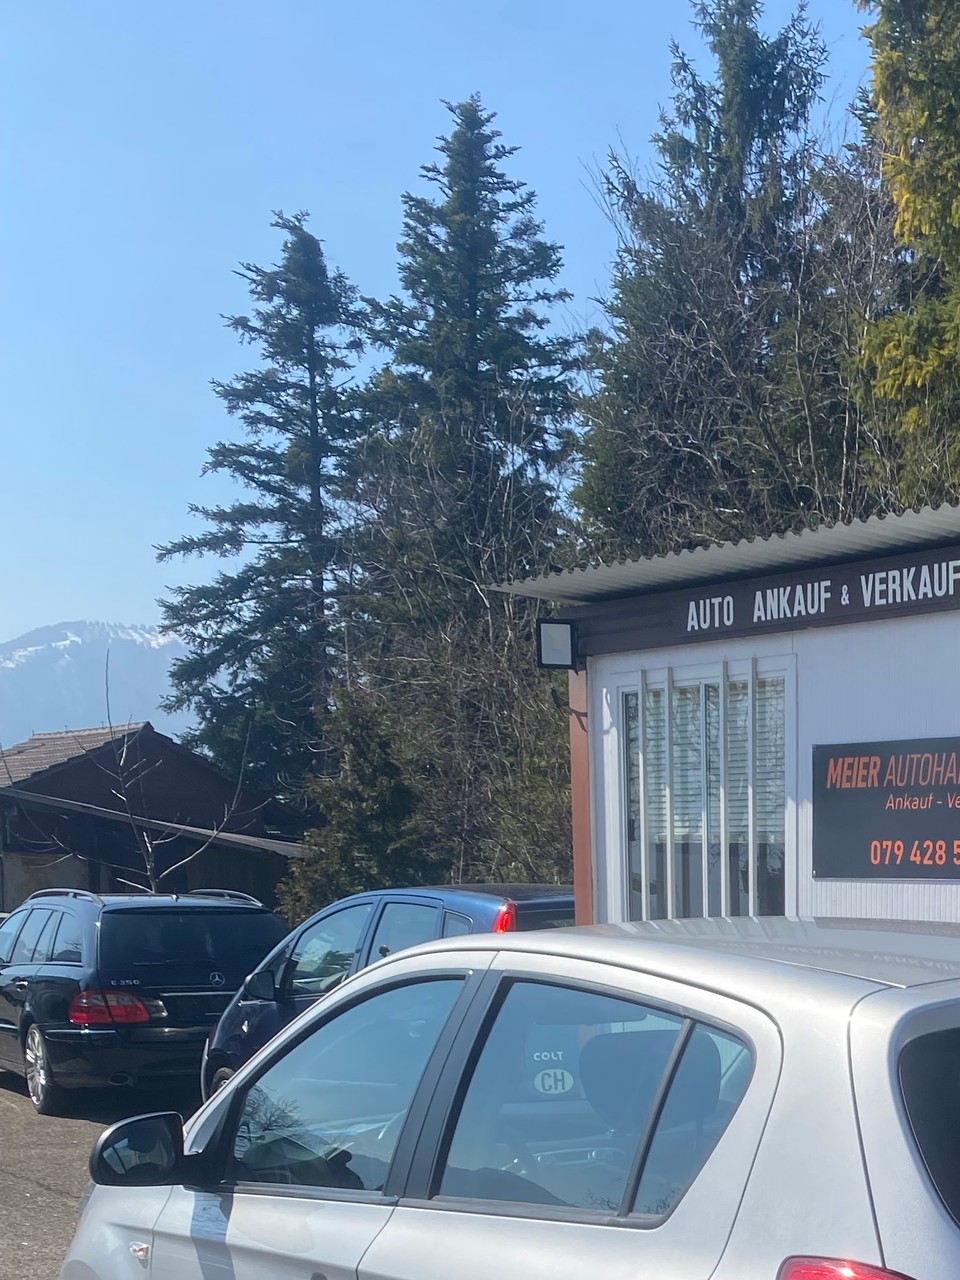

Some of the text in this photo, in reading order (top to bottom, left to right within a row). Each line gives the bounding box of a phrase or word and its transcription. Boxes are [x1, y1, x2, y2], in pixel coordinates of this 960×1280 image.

[686, 595, 735, 632] AUTO
[752, 580, 832, 623] ANKAUF
[840, 584, 850, 606] &
[826, 755, 881, 789] MEIER
[885, 792, 936, 811] Ankauf
[870, 840, 904, 866] 079
[909, 840, 946, 866] 428
[533, 1051, 564, 1061] COLT
[540, 1071, 566, 1092] CH
